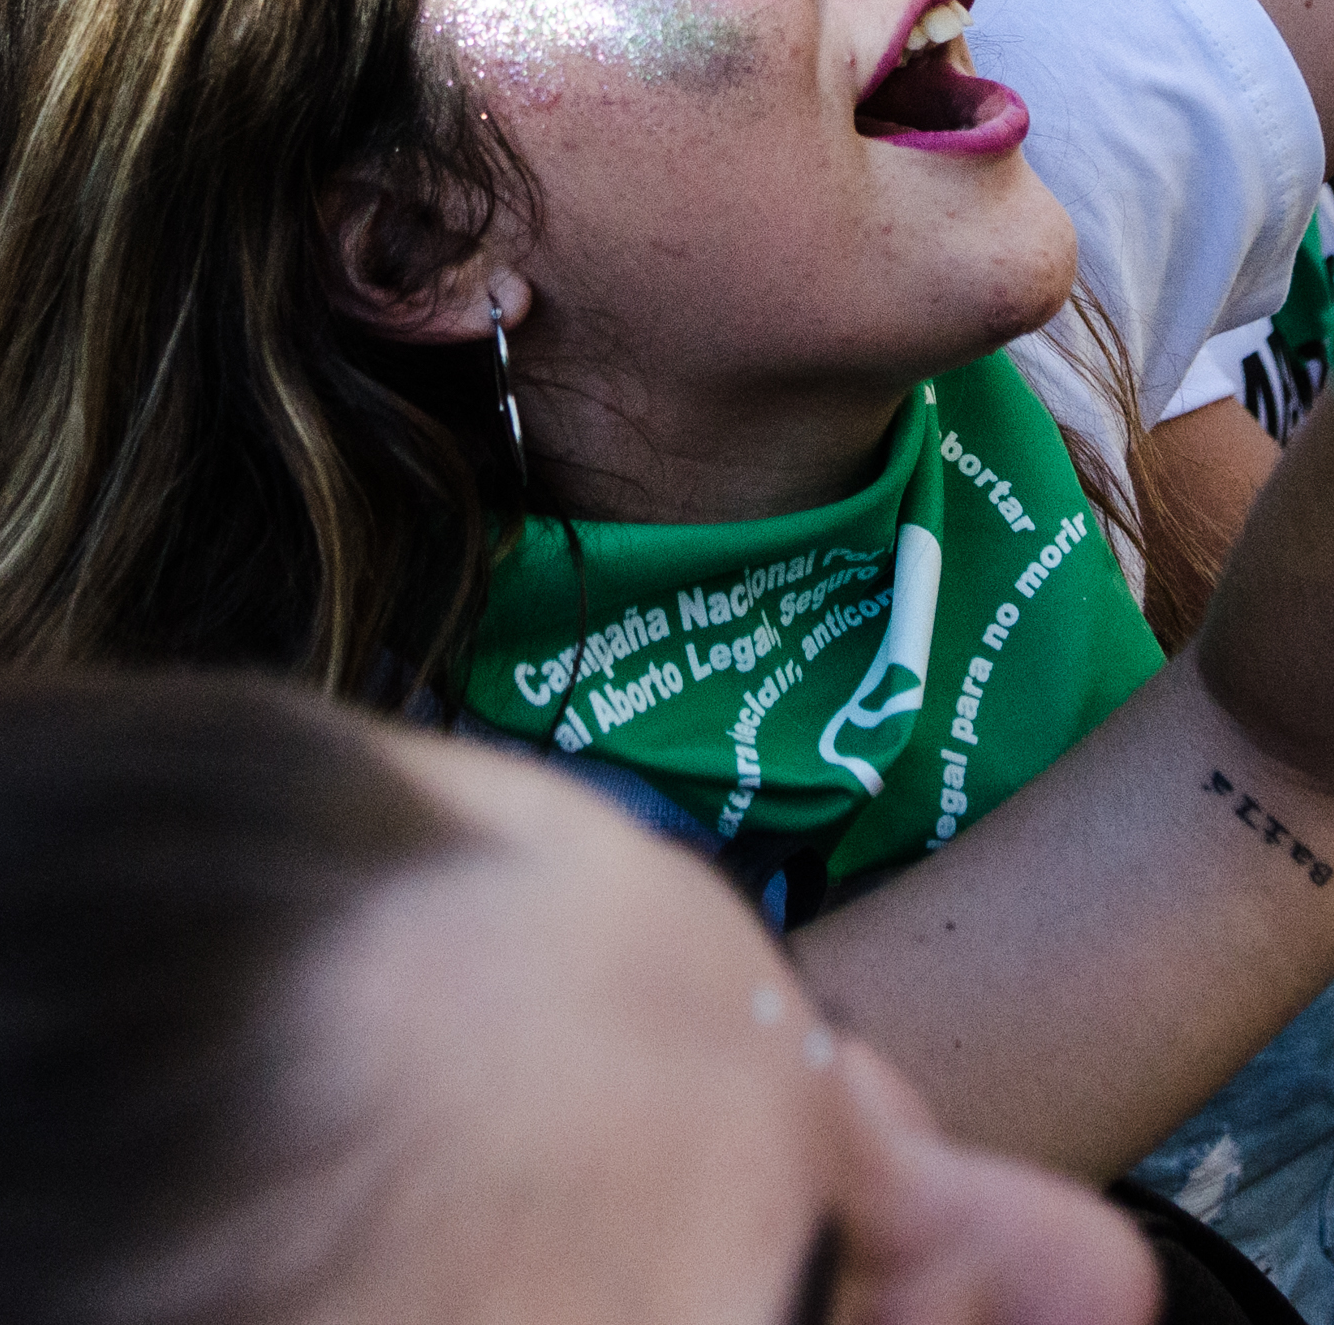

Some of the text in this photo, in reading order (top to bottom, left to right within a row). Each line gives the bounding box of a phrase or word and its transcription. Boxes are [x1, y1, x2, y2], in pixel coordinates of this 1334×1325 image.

[936, 430, 1037, 534] bortar
[514, 606, 670, 707] Campaña
[677, 549, 816, 632] Nacional
[554, 565, 880, 753] al Aborto Legal, Seguro
[925, 512, 1088, 850] legal para no morir
